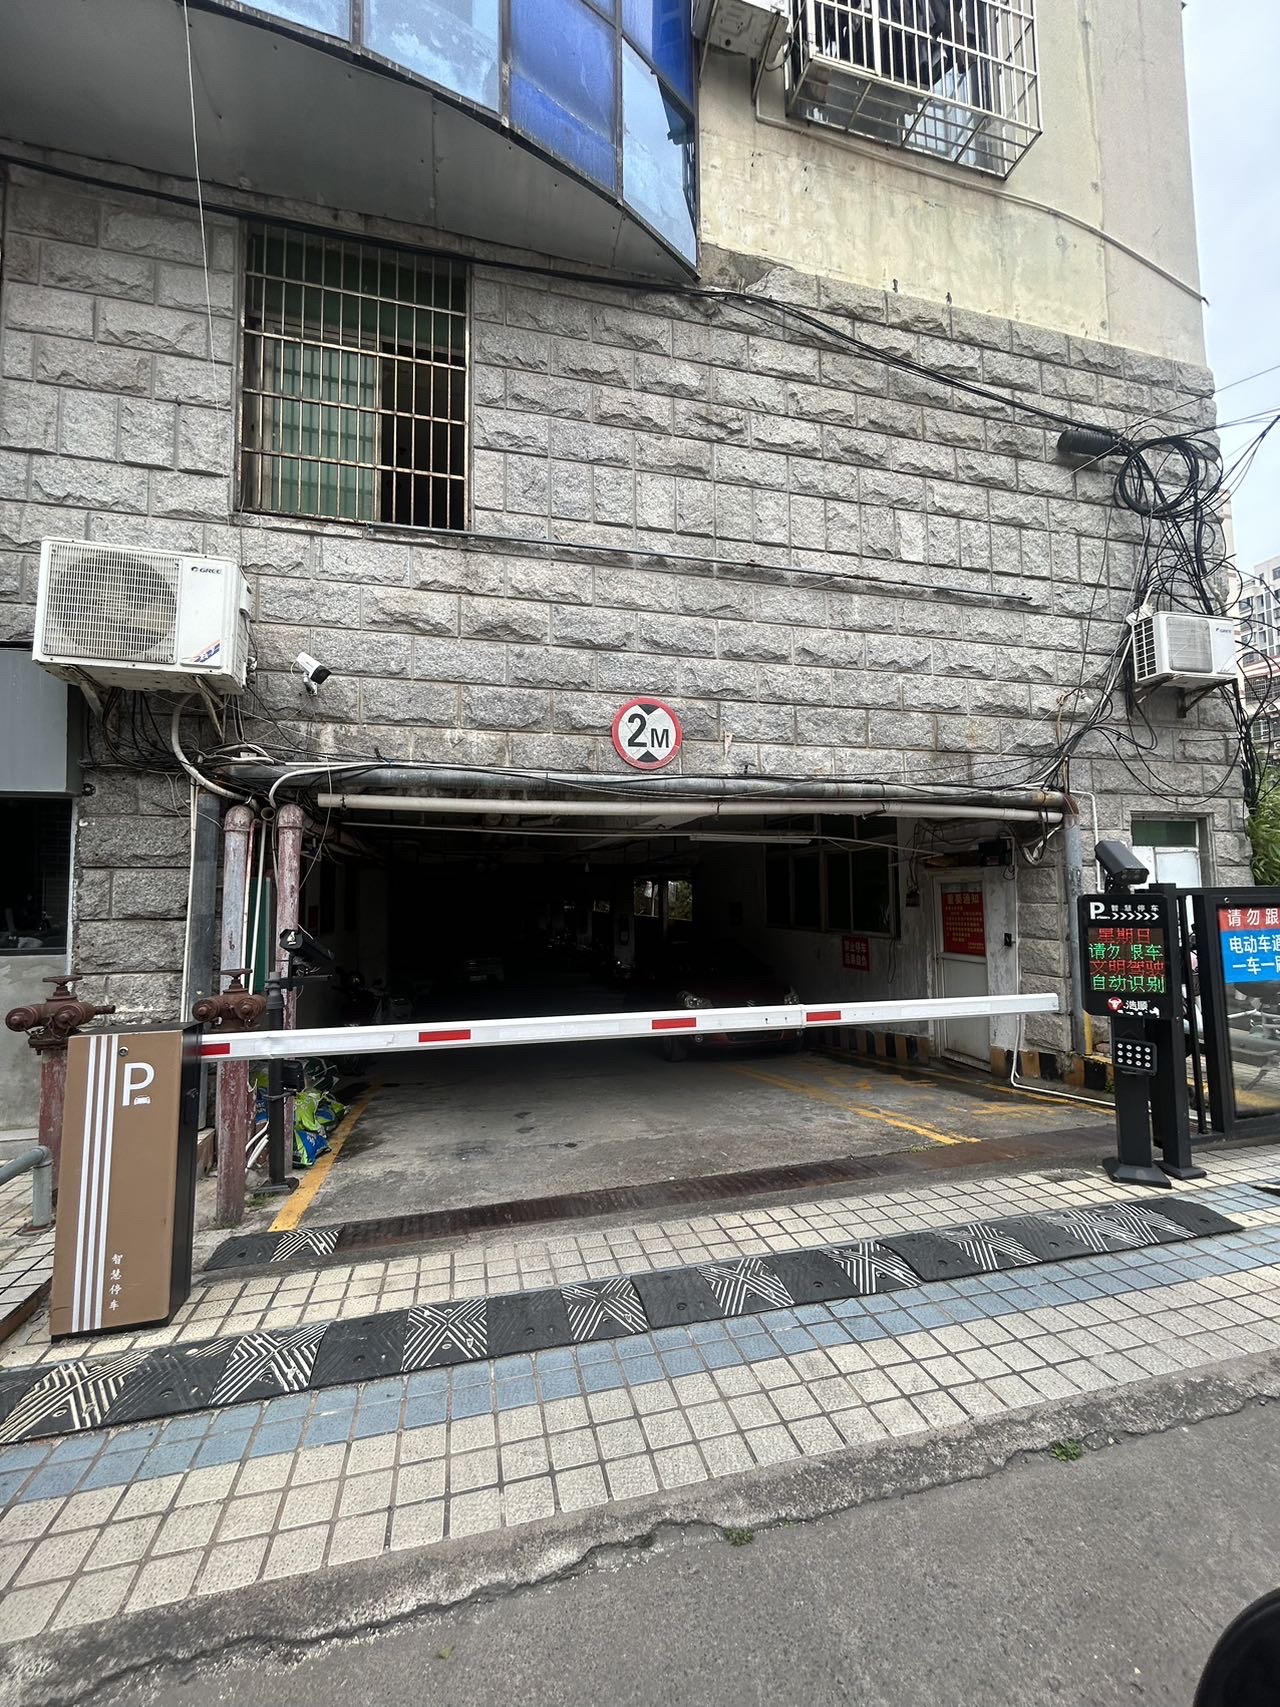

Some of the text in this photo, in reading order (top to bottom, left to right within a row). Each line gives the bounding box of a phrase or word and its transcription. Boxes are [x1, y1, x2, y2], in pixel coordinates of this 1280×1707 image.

[1227, 908, 1280, 926] 请勿跟
[1098, 928, 1151, 944] 星期日
[1090, 960, 1165, 976] 文明驾驶
[1092, 975, 1165, 993] 自动识别
[122, 1062, 155, 1106] P
[109, 1253, 124, 1311] 智慧停车
